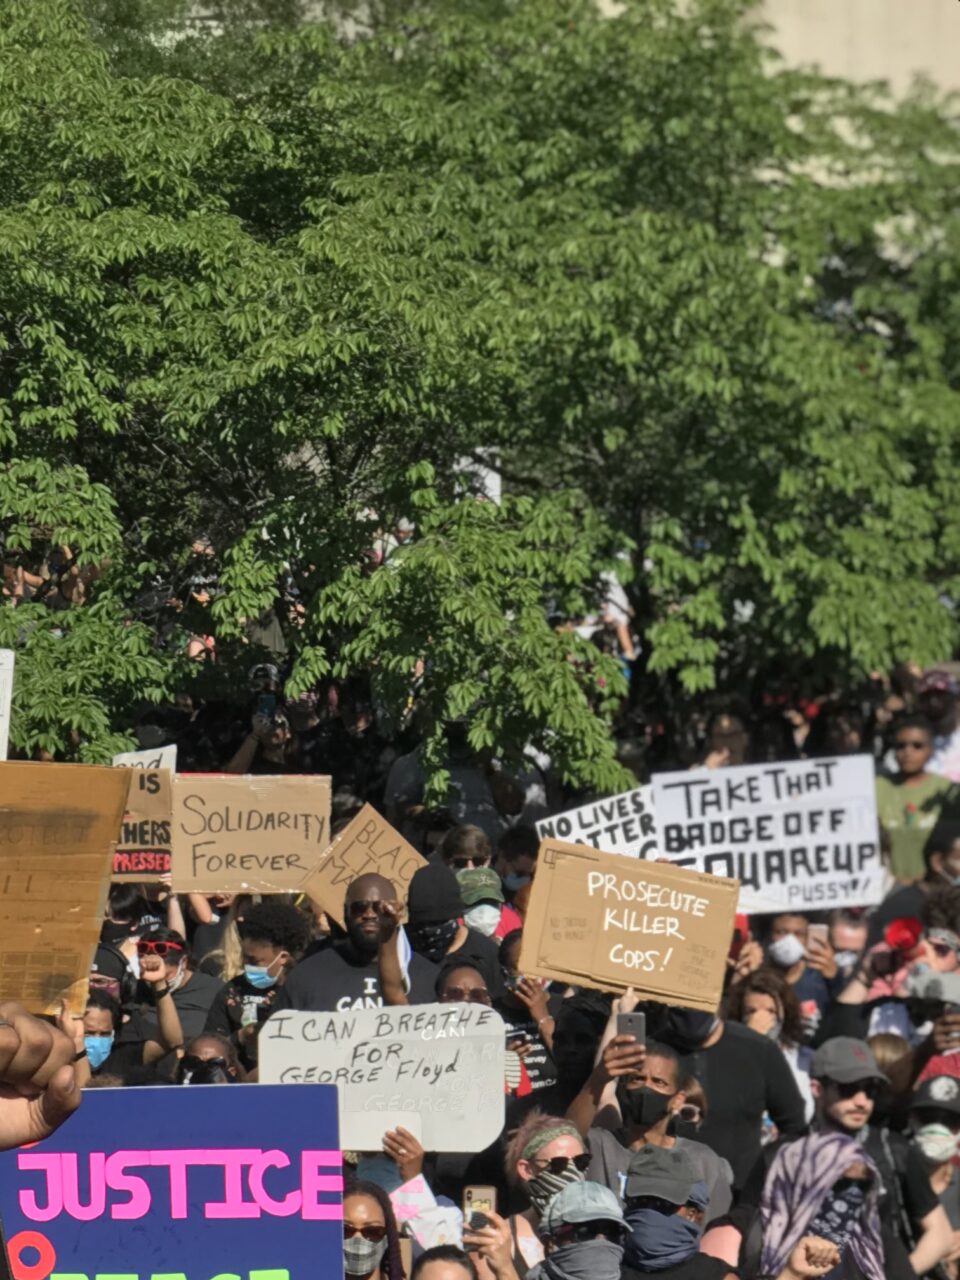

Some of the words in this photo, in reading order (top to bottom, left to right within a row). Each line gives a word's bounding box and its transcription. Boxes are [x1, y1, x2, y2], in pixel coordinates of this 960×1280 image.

[139, 773, 161, 794] IS
[662, 776, 761, 818] TAKE
[764, 760, 838, 800] THAT
[120, 820, 171, 845] HERS
[180, 794, 325, 844] SOLIDARITY
[539, 816, 572, 840] NO
[577, 791, 645, 830] LIVES
[575, 813, 657, 850] TTER
[664, 814, 774, 853] BADGE
[783, 809, 845, 836] OFF
[192, 841, 309, 877] FOREVER
[355, 819, 419, 882] BLAC
[587, 871, 710, 917] PROSECUTE
[603, 908, 686, 940] KILLER
[609, 943, 673, 972] COPS!
[337, 996, 383, 1012] CAN
[268, 1016, 294, 1040] I
[301, 1017, 356, 1042] CAN
[373, 1009, 493, 1038] BREATHE
[279, 1066, 383, 1085] GEORGE
[395, 1049, 461, 1085] Floyd
[351, 1041, 404, 1067] FOR
[18, 1149, 344, 1221] JUSTICE
